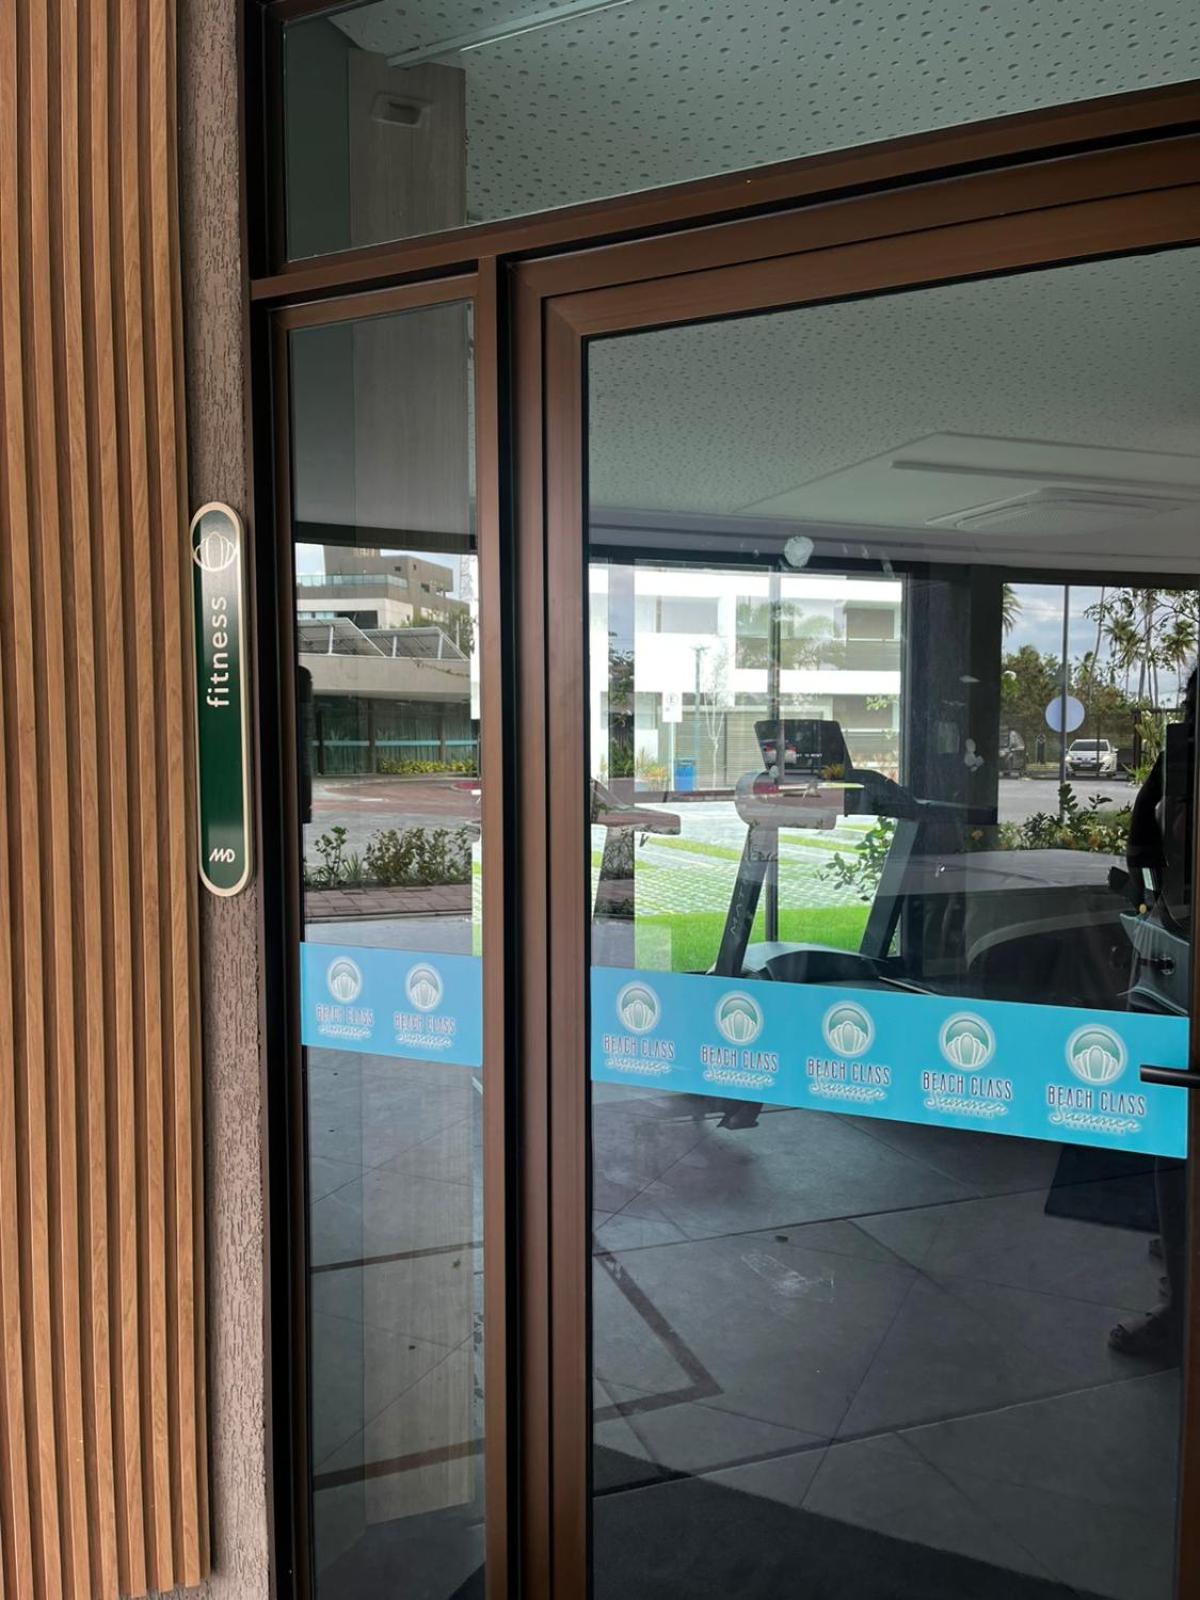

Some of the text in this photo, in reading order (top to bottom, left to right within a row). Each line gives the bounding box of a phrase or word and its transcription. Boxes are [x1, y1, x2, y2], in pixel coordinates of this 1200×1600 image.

[206, 596, 230, 708] fitness
[702, 1046, 778, 1072] BEACH CLASS
[808, 1058, 890, 1086] BEACH CLASS
[923, 1071, 1012, 1100] BEACH CLASS
[1048, 1085, 1146, 1116] BEACH CLASS
